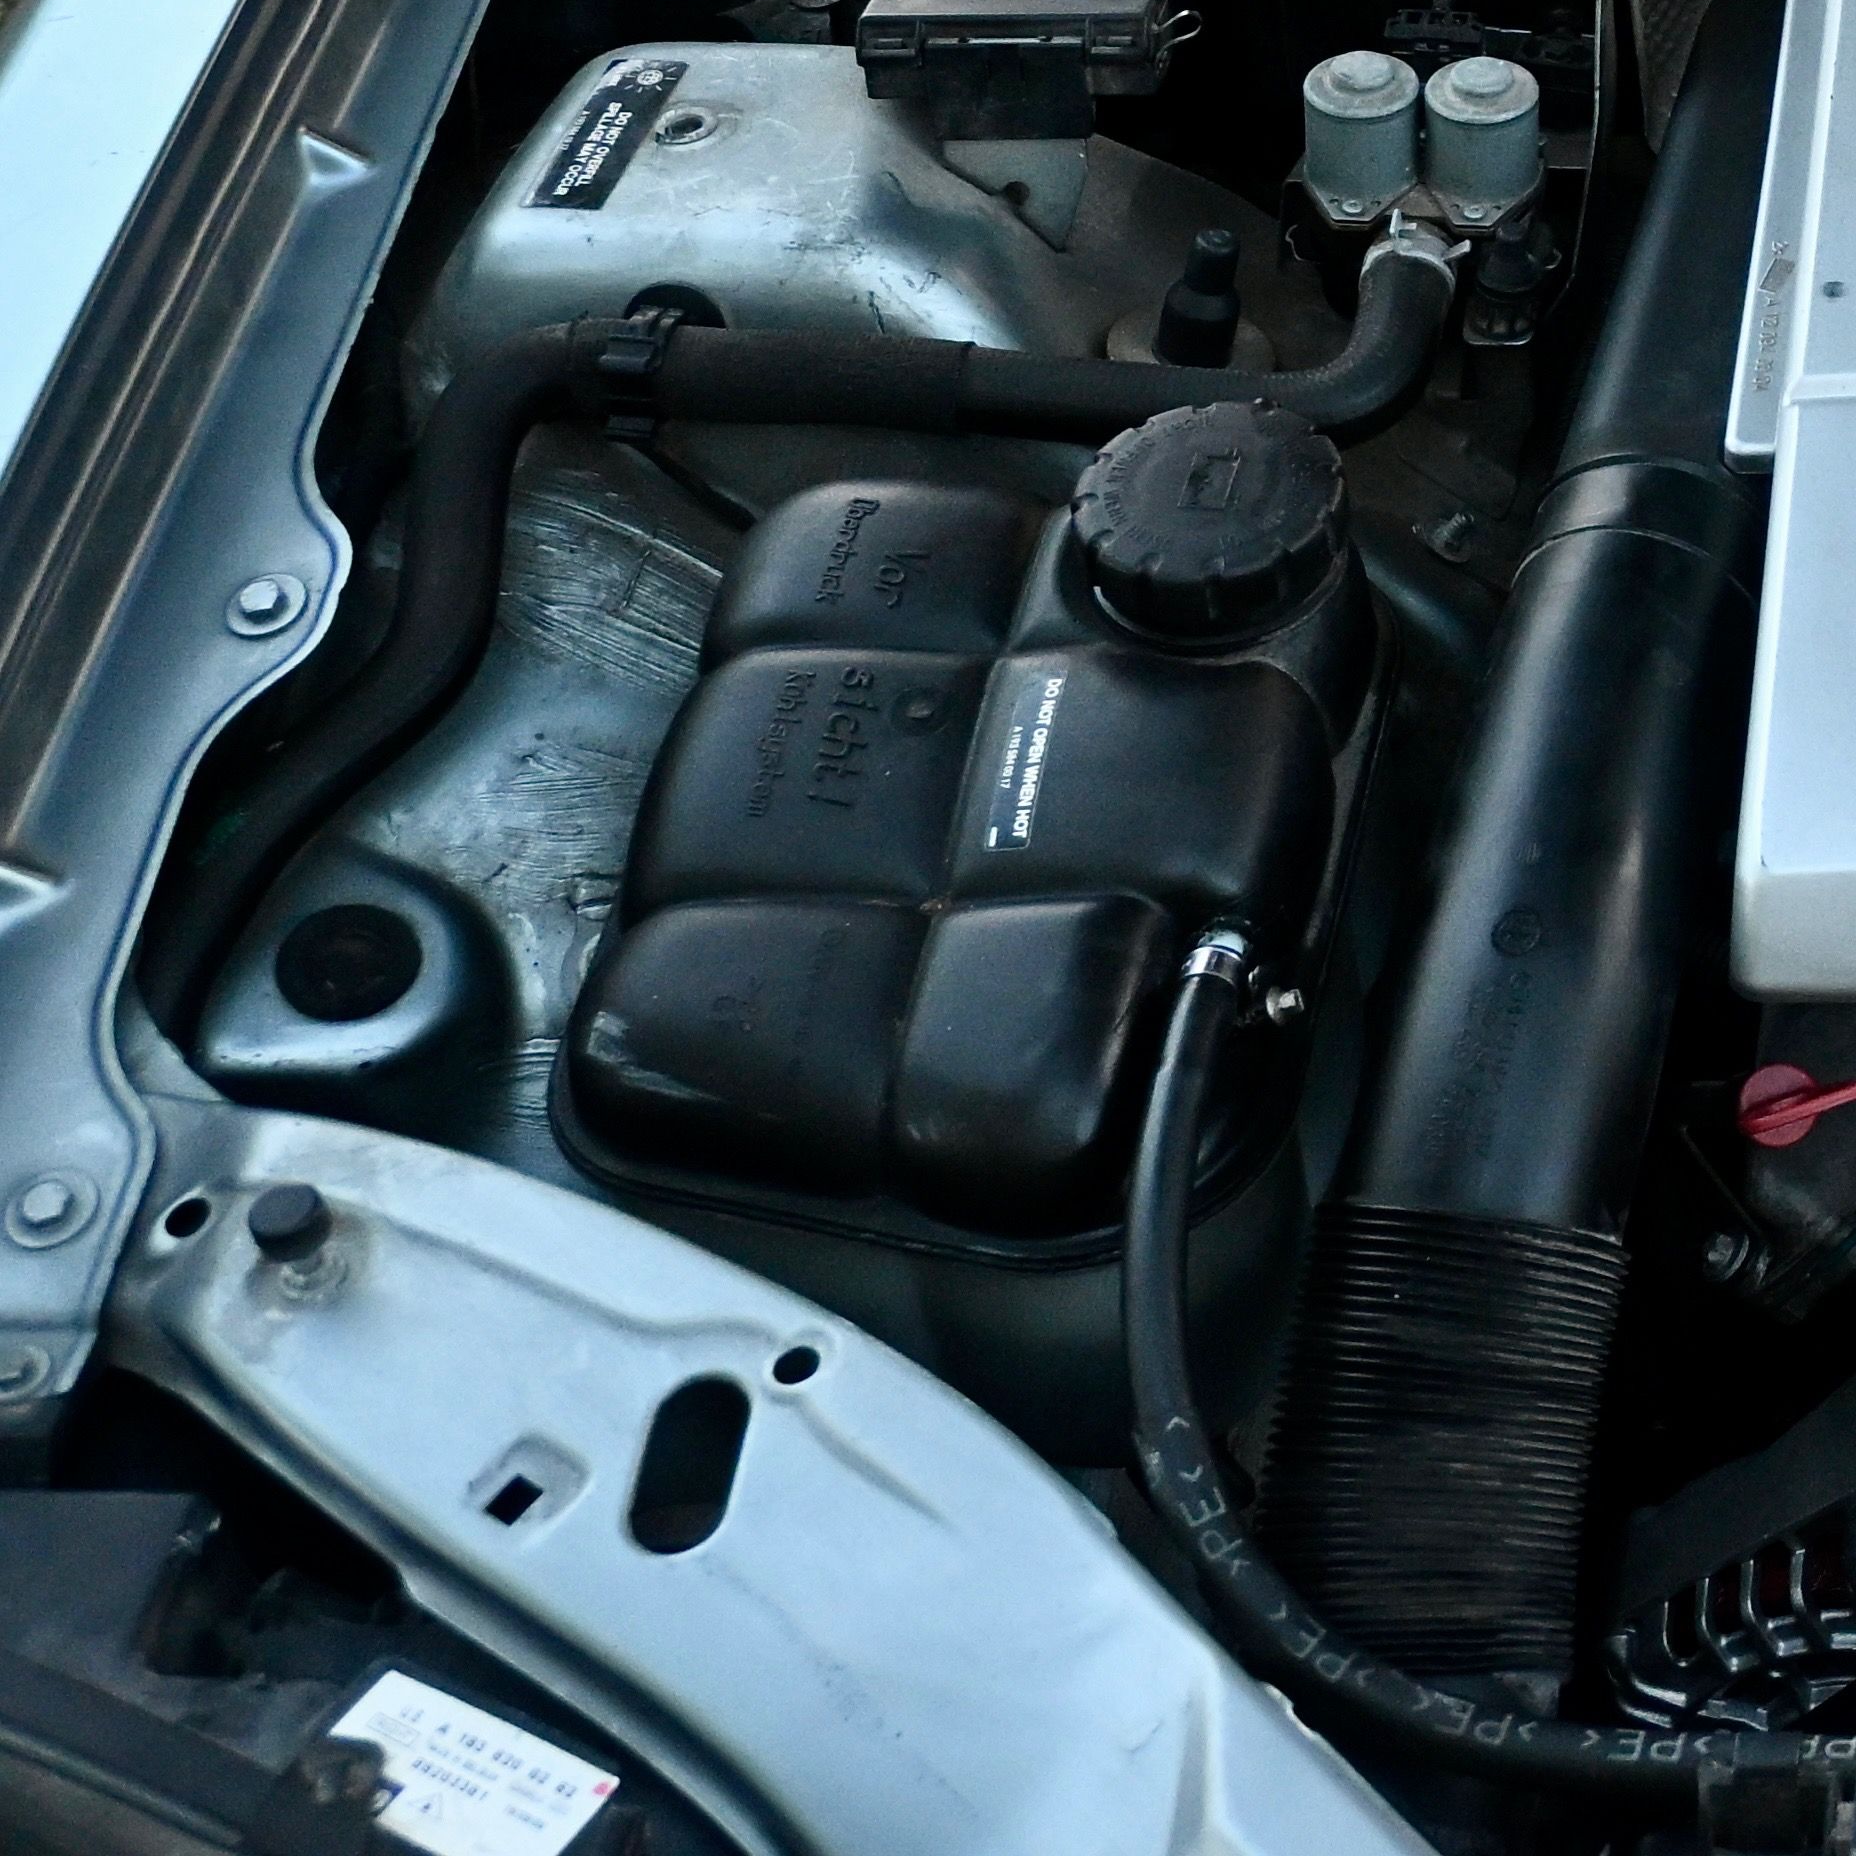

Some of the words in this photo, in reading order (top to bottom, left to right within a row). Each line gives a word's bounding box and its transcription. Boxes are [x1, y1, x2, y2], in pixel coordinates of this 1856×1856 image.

[615, 111, 633, 125] DO
[602, 127, 620, 145] NOT
[573, 143, 596, 163] MAY
[574, 147, 609, 186] OVERFILL
[552, 165, 580, 196] OCCUR
[1044, 678, 1063, 698] DO
[1035, 699, 1057, 726] NOT
[1025, 728, 1048, 763] OPEN
[1016, 766, 1042, 806] WHEN
[1012, 809, 1032, 838] HOT
